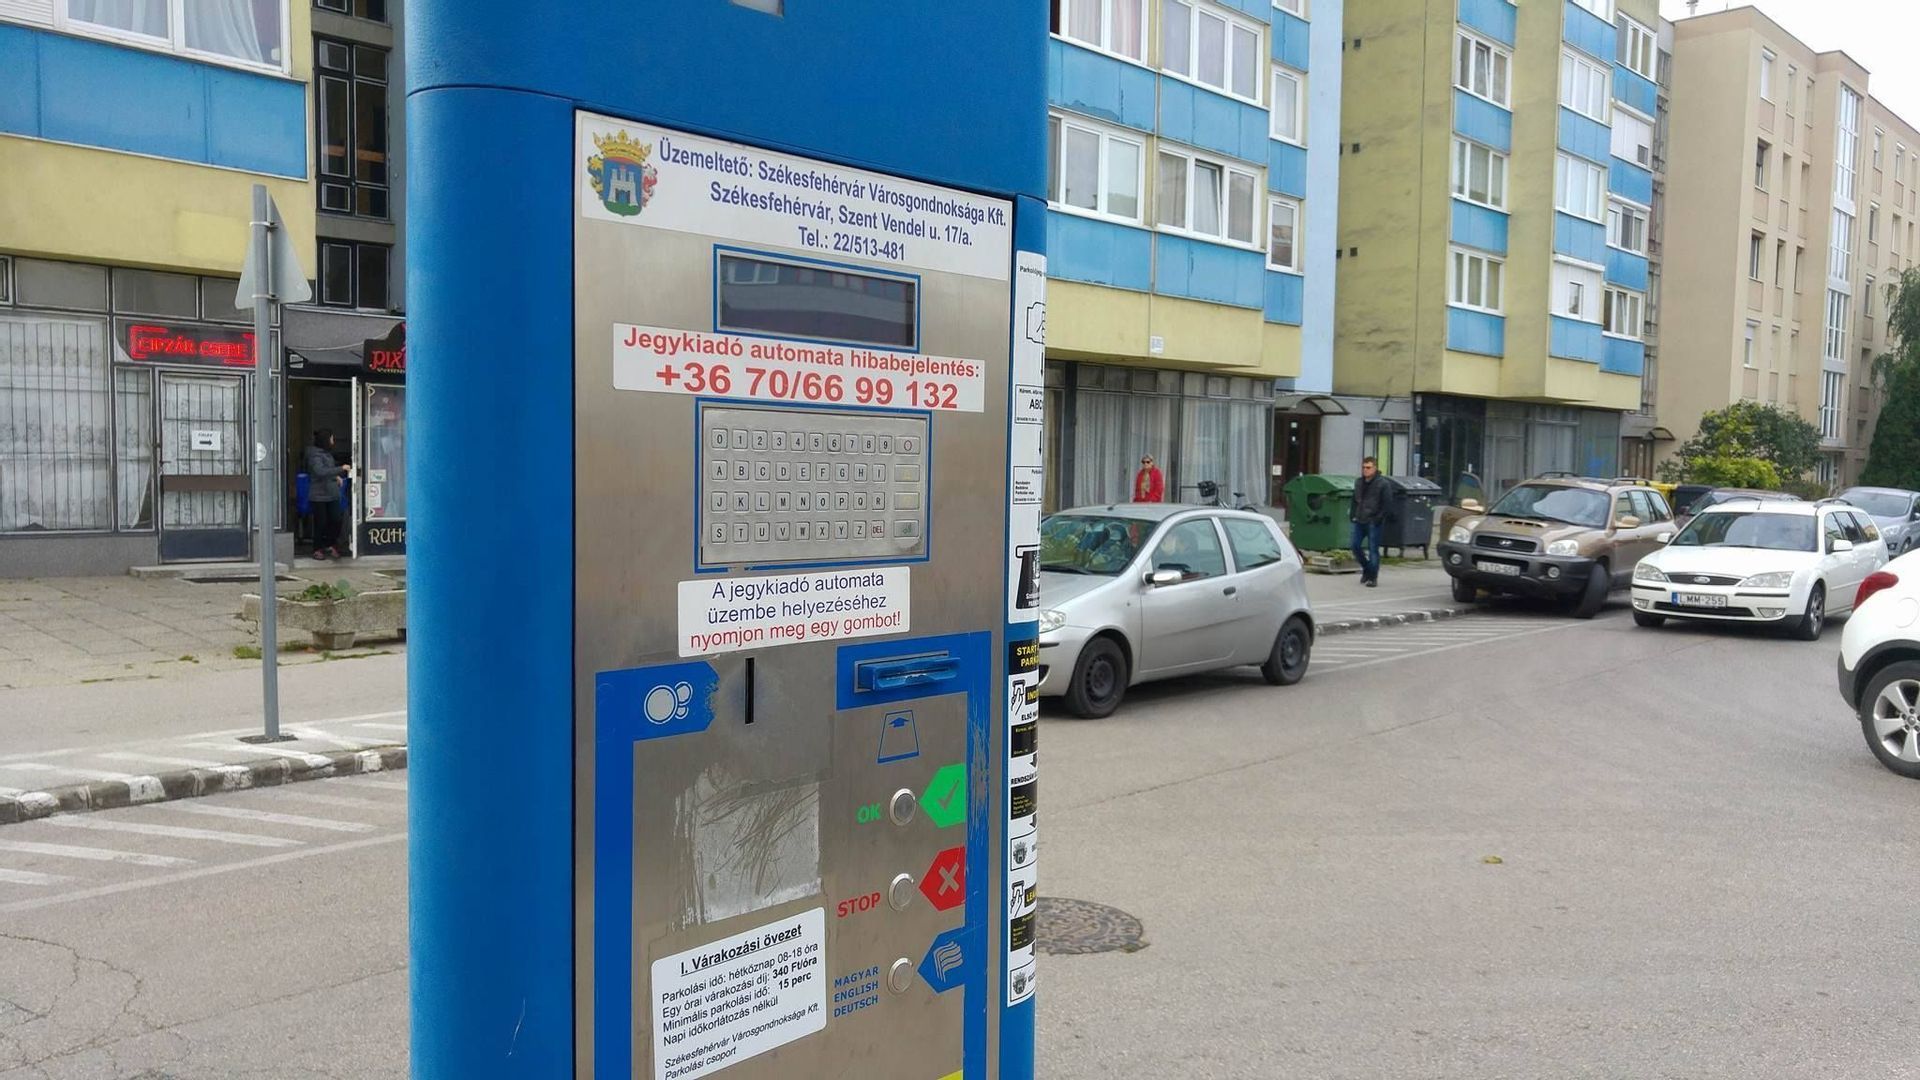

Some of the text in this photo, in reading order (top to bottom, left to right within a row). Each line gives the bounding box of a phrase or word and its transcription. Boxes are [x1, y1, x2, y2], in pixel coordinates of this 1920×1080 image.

[660, 137, 1006, 226] Üzemeltető: Székesfehérvár Városgondnoksága Kft.
[711, 181, 972, 246] Székesfehérvár, Szent Vendel u. 17/a.
[798, 226, 905, 260] Tel.: 22/513-481
[624, 327, 980, 378] Jegykiadó automata hibabejelentés:
[656, 362, 958, 409] +36 70/66 99 132
[716, 435, 888, 449] 0 1 2 3 4 5 6 7 8 9
[716, 466, 880, 478] A B C D E F G H I
[716, 497, 881, 507] J K L M N O P Q R
[368, 528, 406, 545] RUH
[716, 525, 883, 538] S T U V W X Y Z DEL
[712, 571, 884, 601] A jegykiadó automata
[708, 594, 887, 624] üzembe helyezéséhez
[691, 610, 901, 651] nyomjon meg egy gombot!
[856, 803, 881, 824] OK
[837, 892, 881, 919] STOP
[681, 924, 802, 975] I. Várakozási övezet
[662, 943, 818, 1004] Parkolási idő: hétköznap 08-18 óra
[663, 957, 817, 1018] Egy órai várakozási díj: 340 Ft/óra
[834, 966, 879, 988] MAGYAR
[663, 972, 811, 1032] Minimális parkolási idő: 15 perc
[834, 981, 879, 1003] ENGLISH
[834, 995, 878, 1017] DEUTSCH
[664, 995, 778, 1047] Napi időkorlátozás nélkül
[665, 1002, 819, 1068] Székesfehérvár Városgondnoksága Kft.
[665, 1046, 736, 1080] Parkolási csoport
